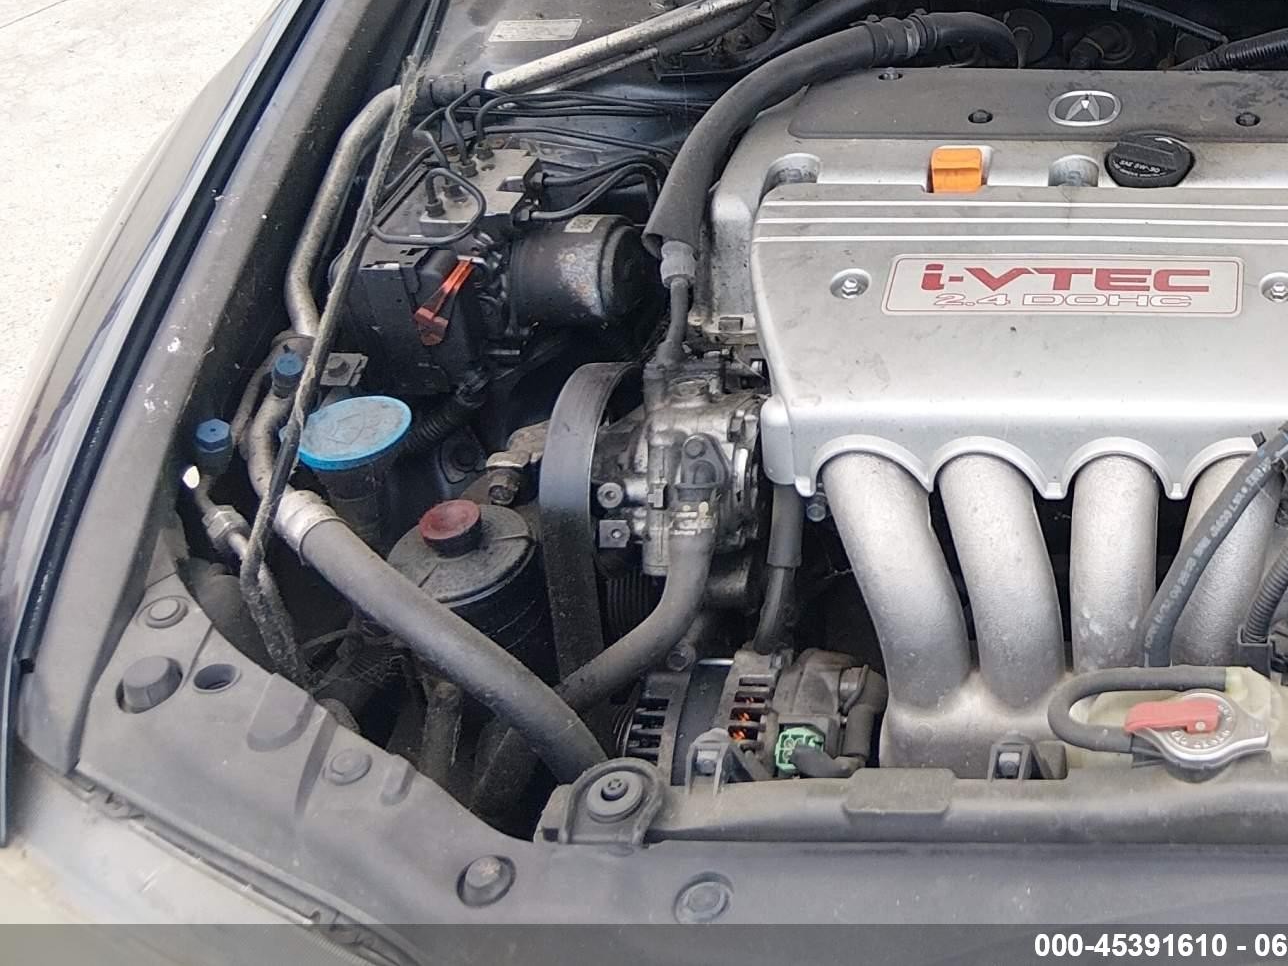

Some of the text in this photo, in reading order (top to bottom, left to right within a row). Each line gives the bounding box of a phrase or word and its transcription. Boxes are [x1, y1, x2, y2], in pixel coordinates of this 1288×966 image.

[921, 264, 1210, 292] i-VTEC
[934, 294, 1192, 308] 2.4 DOHC
